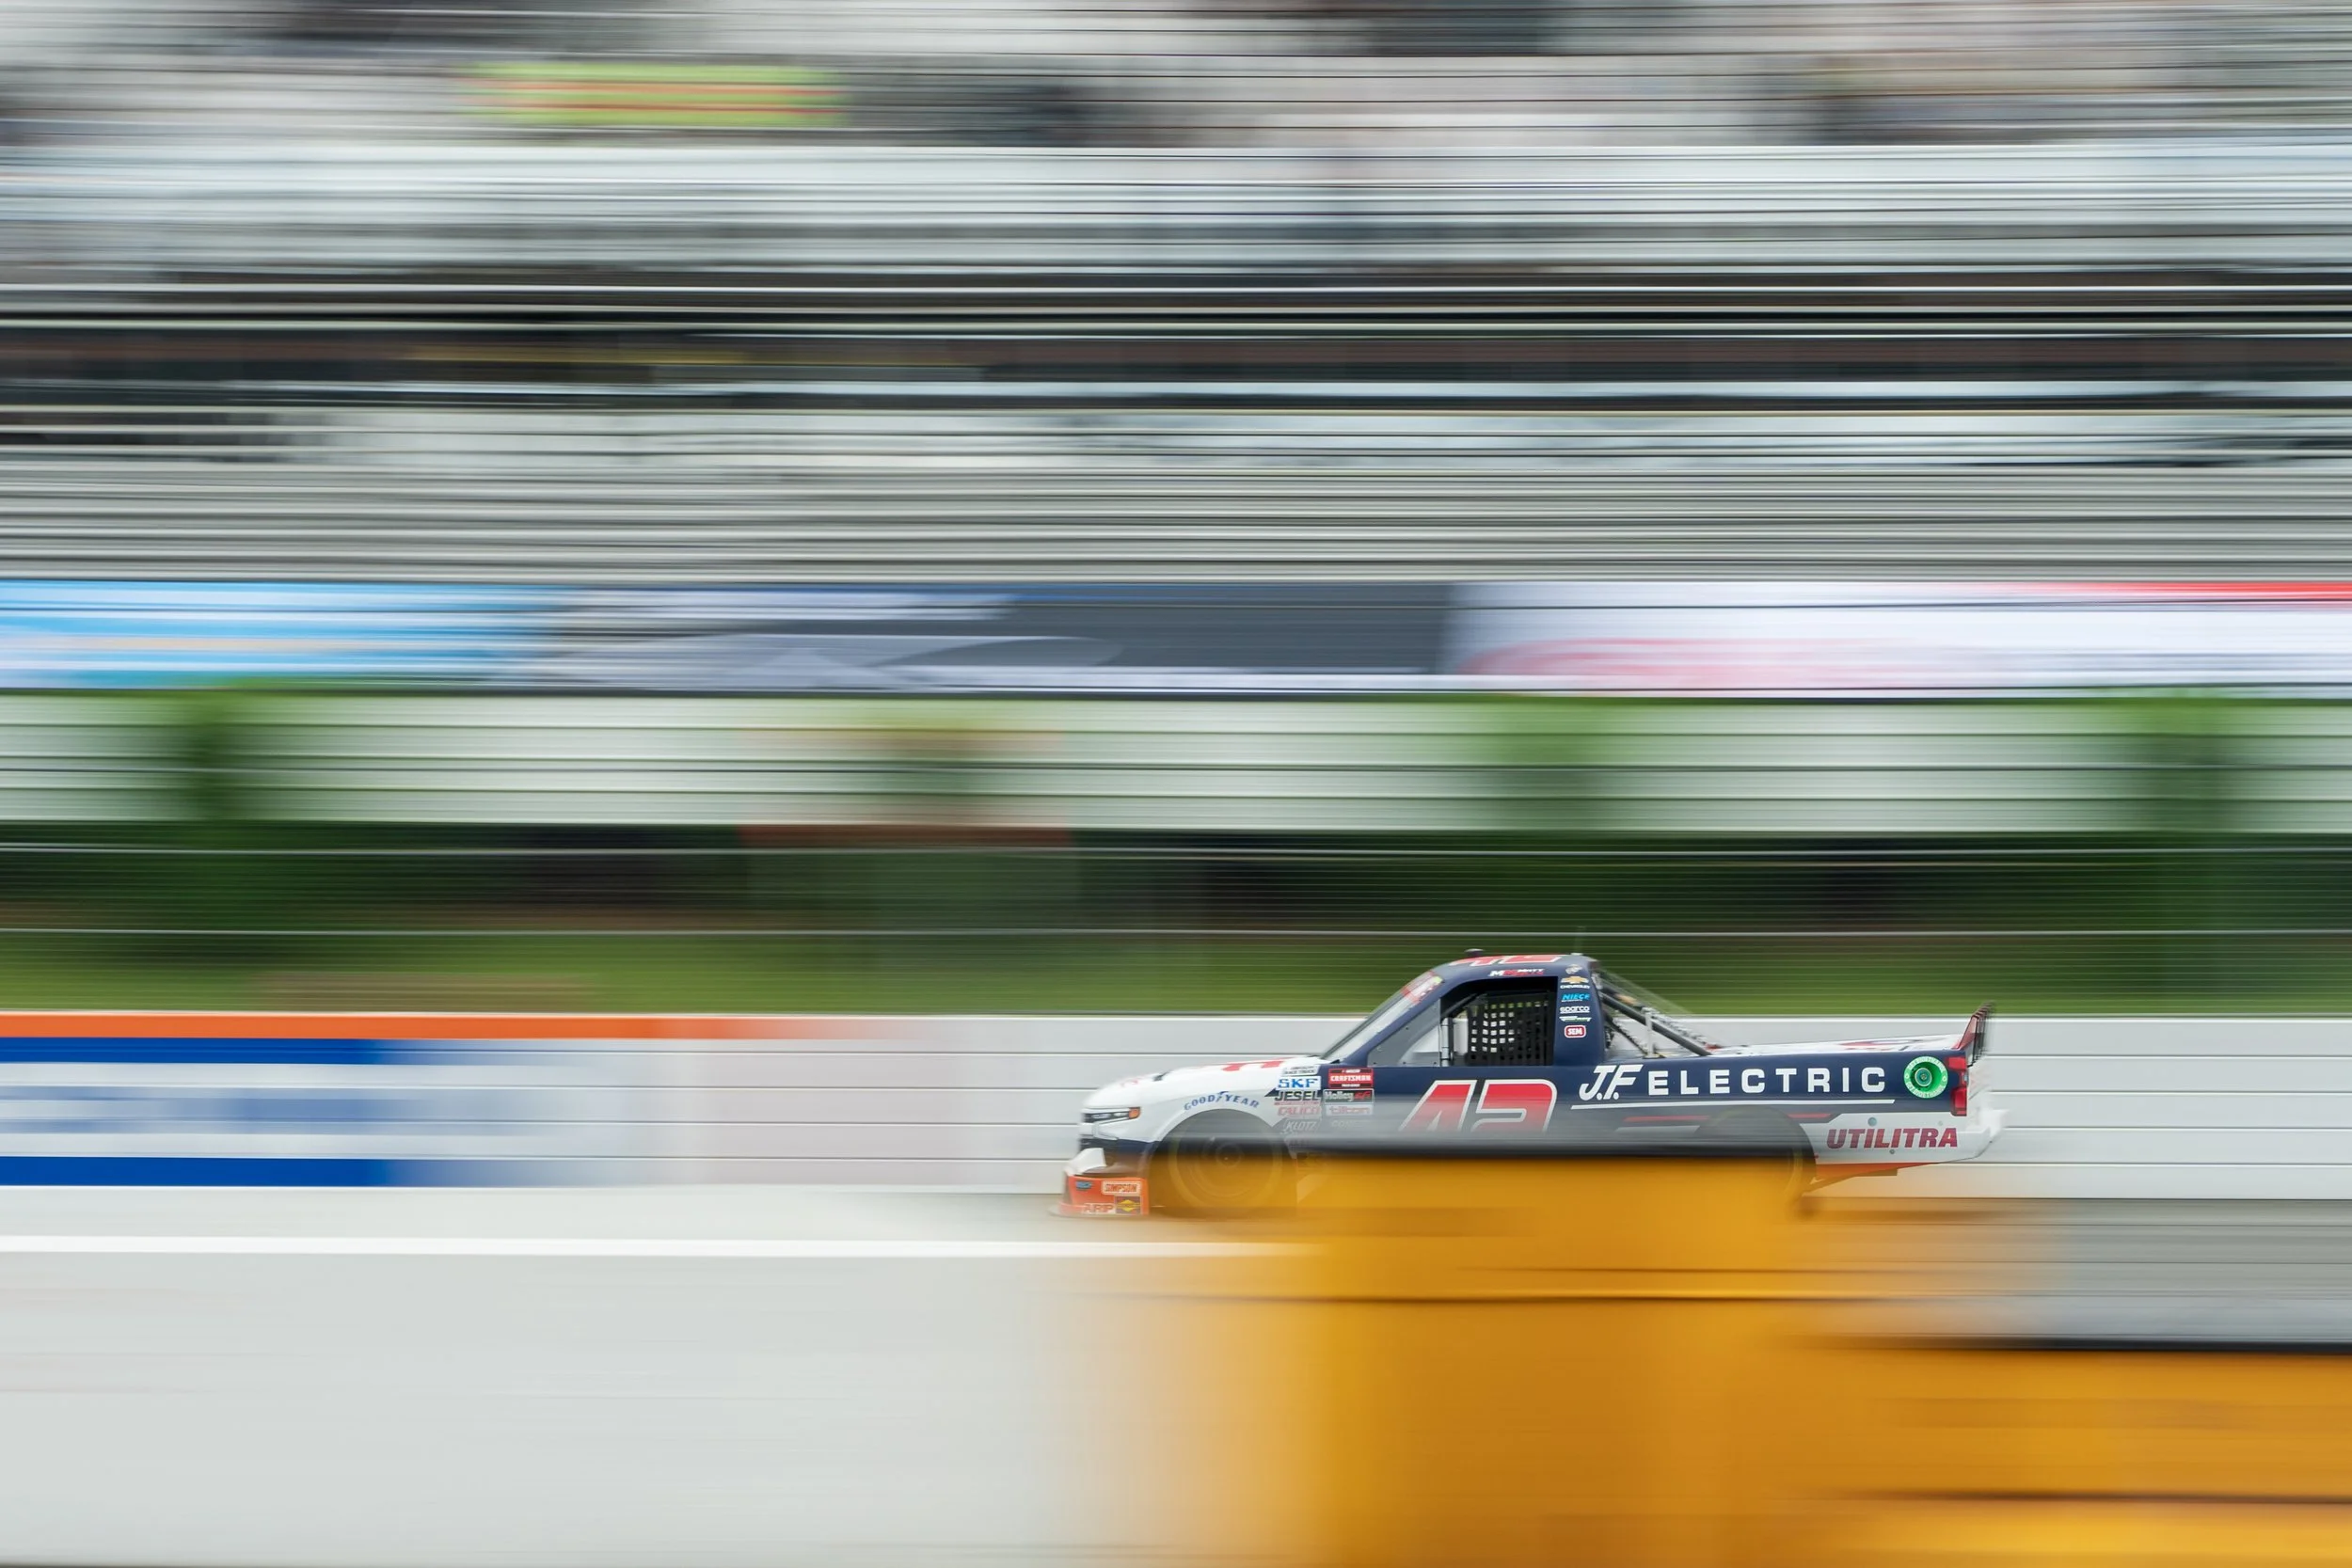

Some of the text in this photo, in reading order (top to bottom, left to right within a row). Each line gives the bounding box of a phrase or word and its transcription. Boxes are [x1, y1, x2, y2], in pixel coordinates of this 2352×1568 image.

[1562, 992, 1590, 1001] NIECE
[1567, 1027, 1583, 1036] SEM
[1278, 1078, 1318, 1088] SKF
[1648, 1067, 1885, 1096] ELECTRIC
[1184, 1091, 1260, 1111] GOODYEAR
[1274, 1090, 1319, 1101] JESEL
[1324, 1091, 1354, 1102] Holley
[1826, 1127, 1958, 1149] UTILITRA
[1104, 1183, 1138, 1194] SIMPSON
